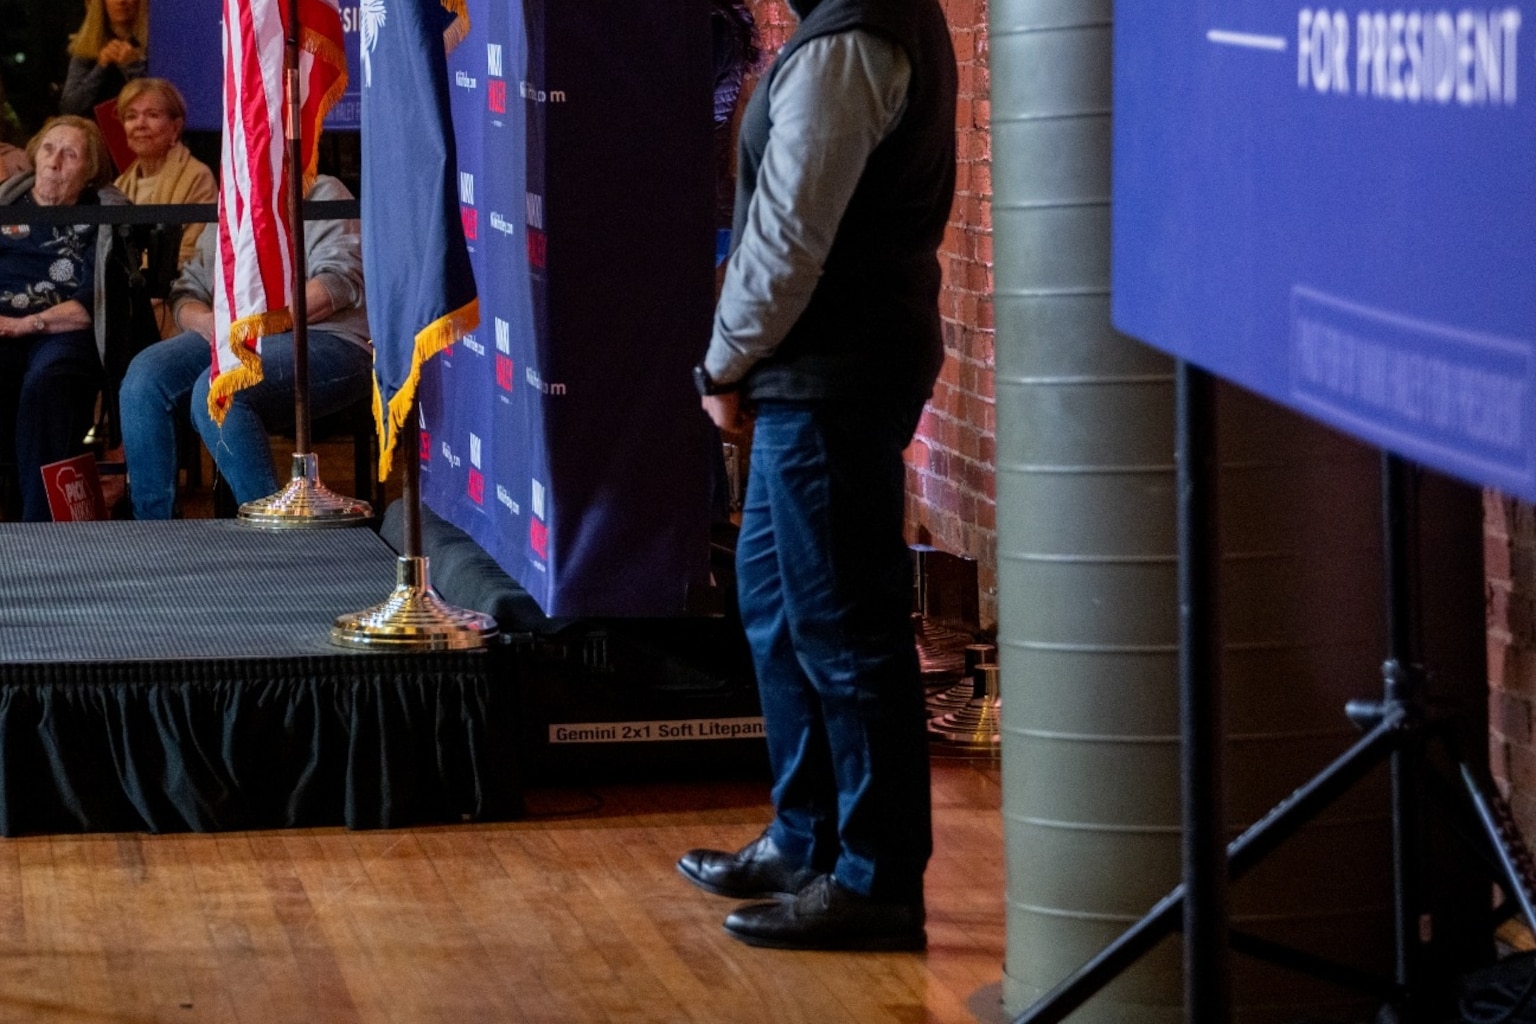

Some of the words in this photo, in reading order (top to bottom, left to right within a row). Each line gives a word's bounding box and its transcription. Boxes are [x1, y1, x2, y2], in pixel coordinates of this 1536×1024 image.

[1297, 7, 1350, 94] FOR
[1356, 7, 1521, 107] PRESIDENT
[556, 726, 616, 742] Gemini
[622, 726, 651, 739] 2x1
[658, 723, 694, 738] Soft
[699, 721, 766, 737] Litepan
